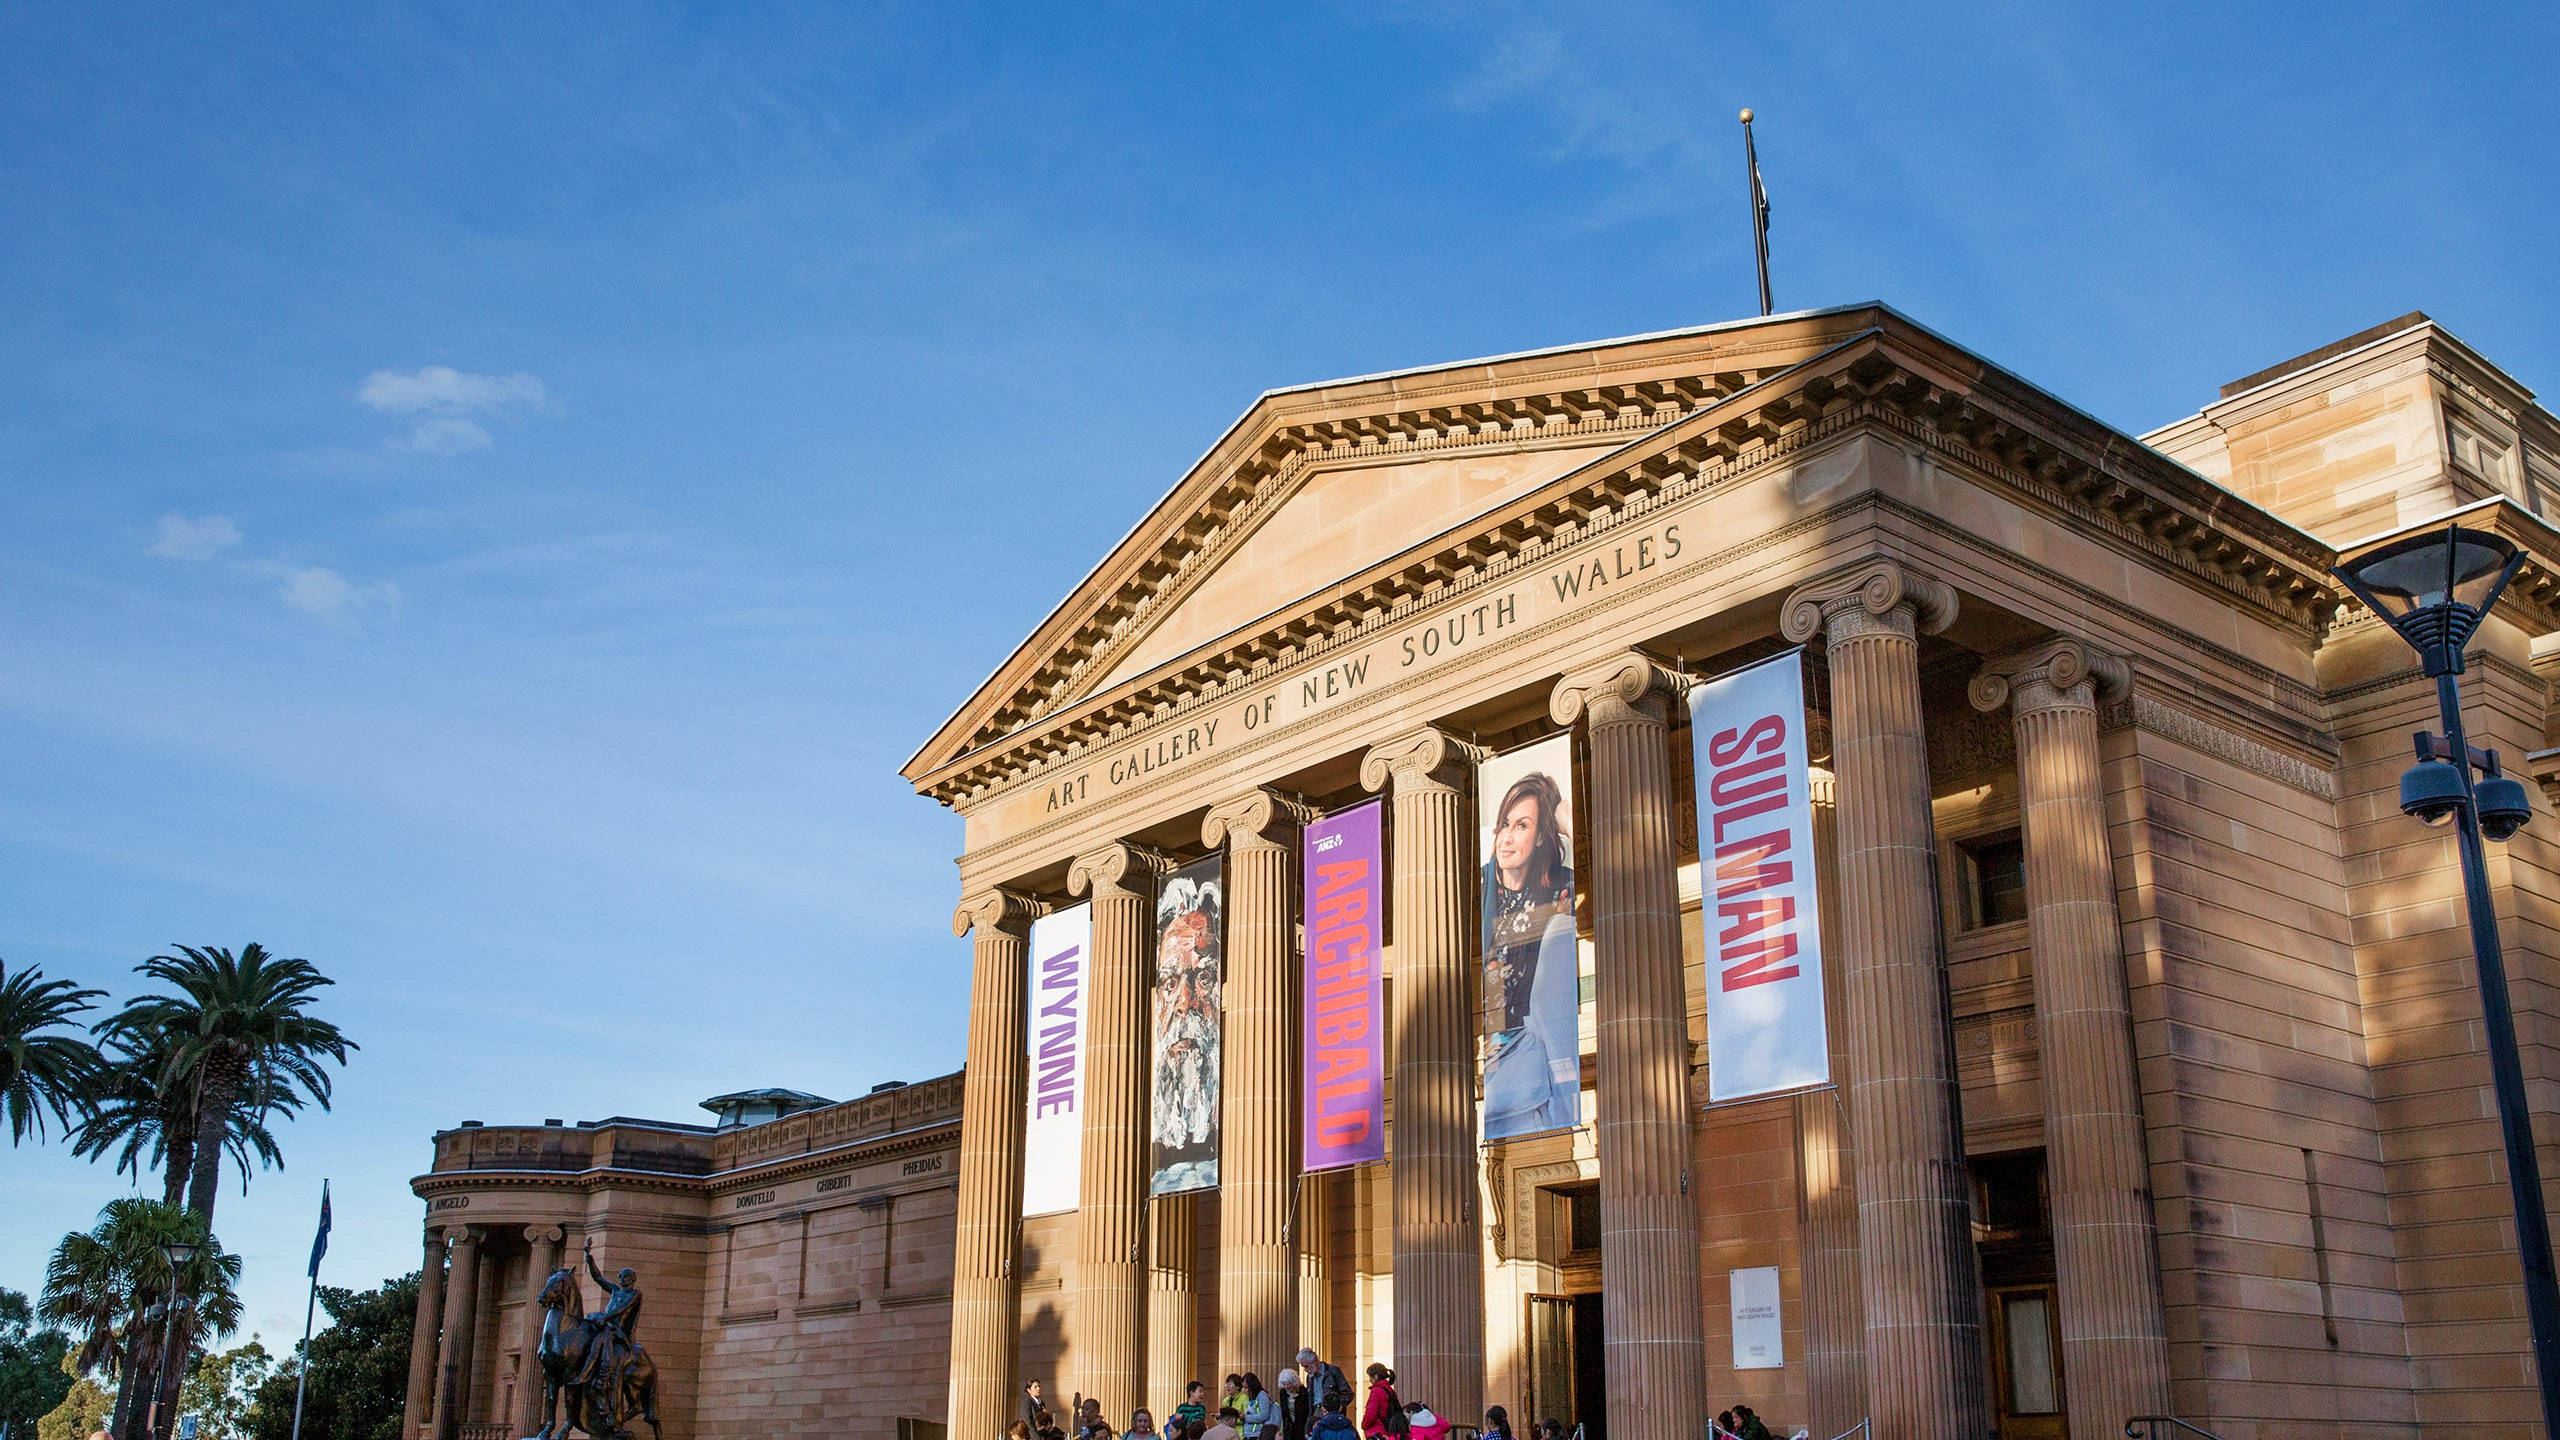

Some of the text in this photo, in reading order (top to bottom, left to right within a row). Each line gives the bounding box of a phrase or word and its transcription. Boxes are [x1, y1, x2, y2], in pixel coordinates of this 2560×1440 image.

[1046, 525, 1682, 813] ART GALLERY OF NEW SOUTH WALES
[1709, 714, 1800, 993] SULMAN
[1036, 944, 1080, 1120] WYNNE
[1315, 858, 1369, 1148] ARCHIBALD
[436, 1196, 469, 1209] ANGELO
[736, 1190, 775, 1209] DONATELLO
[816, 1174, 852, 1193] GHIBERTI
[903, 1156, 942, 1176] PHEIDIAS
